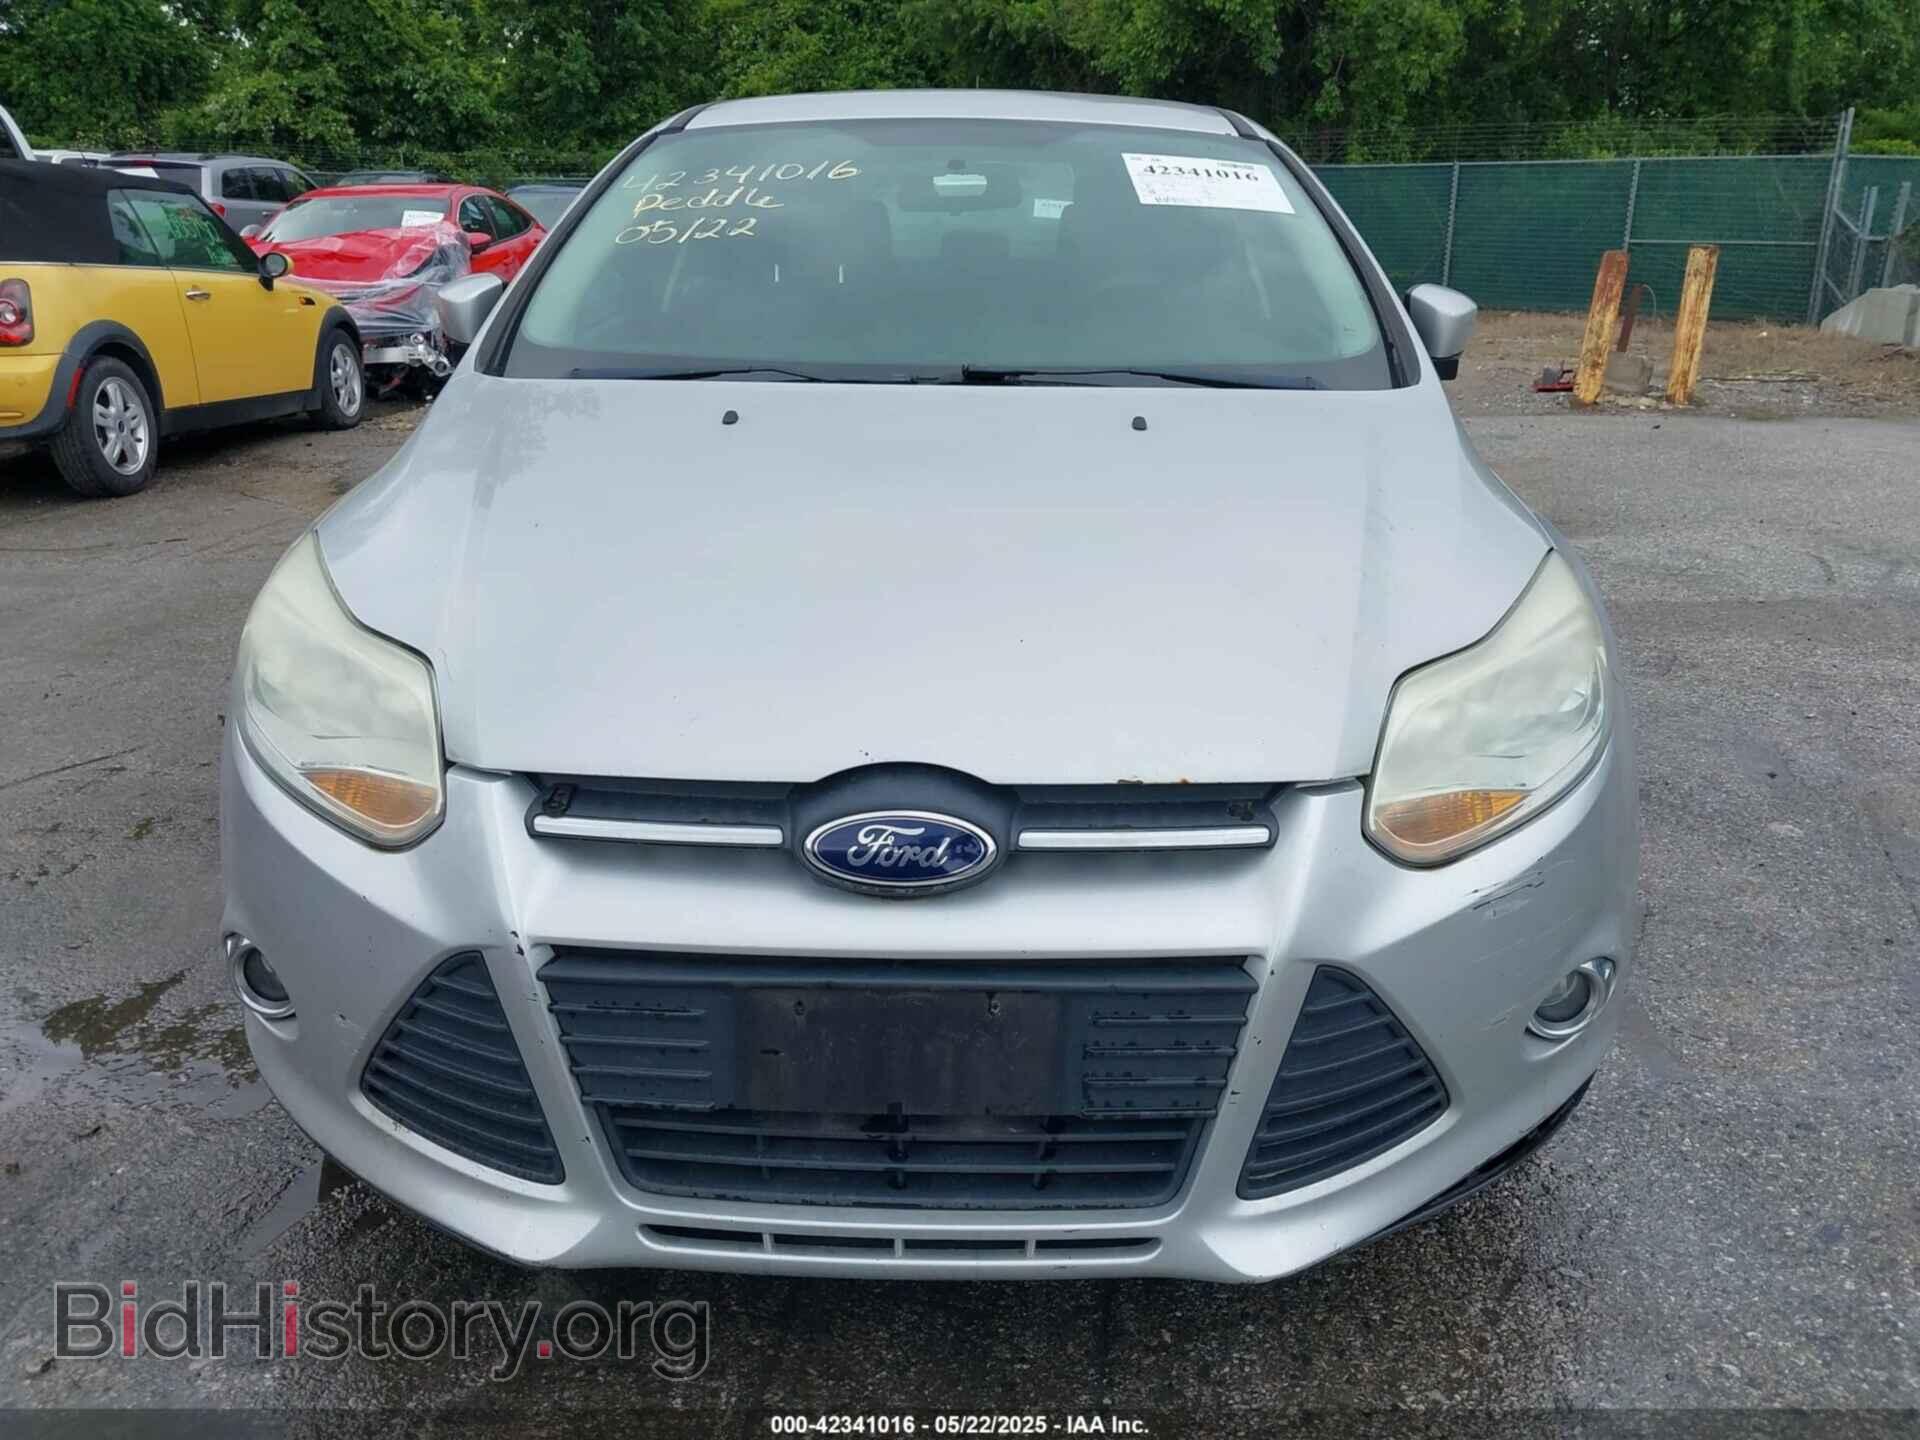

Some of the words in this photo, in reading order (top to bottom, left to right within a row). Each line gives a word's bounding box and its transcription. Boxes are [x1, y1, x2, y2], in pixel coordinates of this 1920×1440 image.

[1143, 164, 1259, 182] 42341016
[615, 217, 758, 245] 05/22
[846, 824, 948, 868] Ford
